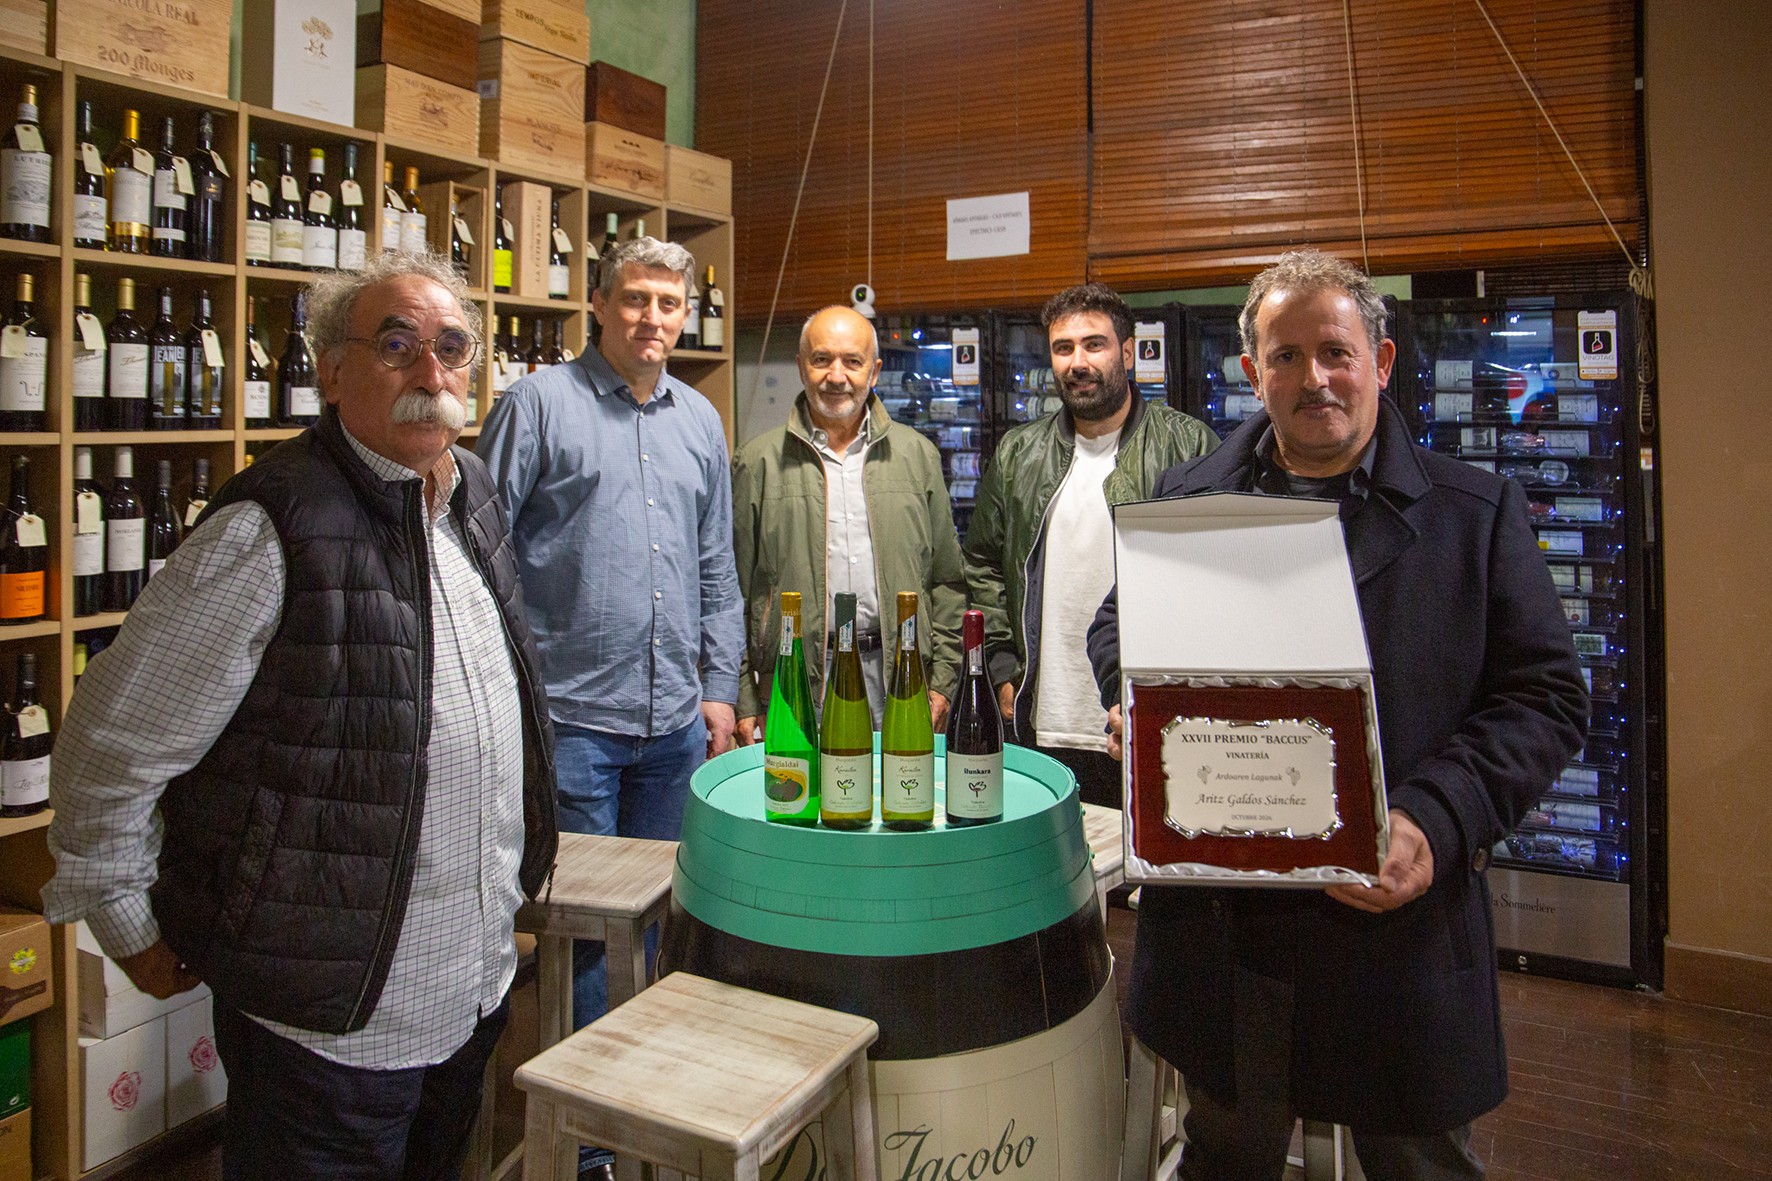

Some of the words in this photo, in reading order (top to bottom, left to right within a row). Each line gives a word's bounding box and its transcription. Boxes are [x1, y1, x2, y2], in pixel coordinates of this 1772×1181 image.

[97, 45, 130, 66] 200
[131, 53, 196, 83] Monges
[1181, 734, 1211, 743] XXVII
[1214, 734, 1258, 744] PREMIO
[1225, 751, 1270, 760] VINATERÍA
[1215, 772, 1250, 780] Ardoaren
[1251, 773, 1283, 782] Lagunak
[1195, 793, 1224, 804] Aritz
[1227, 793, 1262, 807] Galdos
[1264, 794, 1307, 806] Sánchez
[1500, 893, 1556, 914] Sommelière
